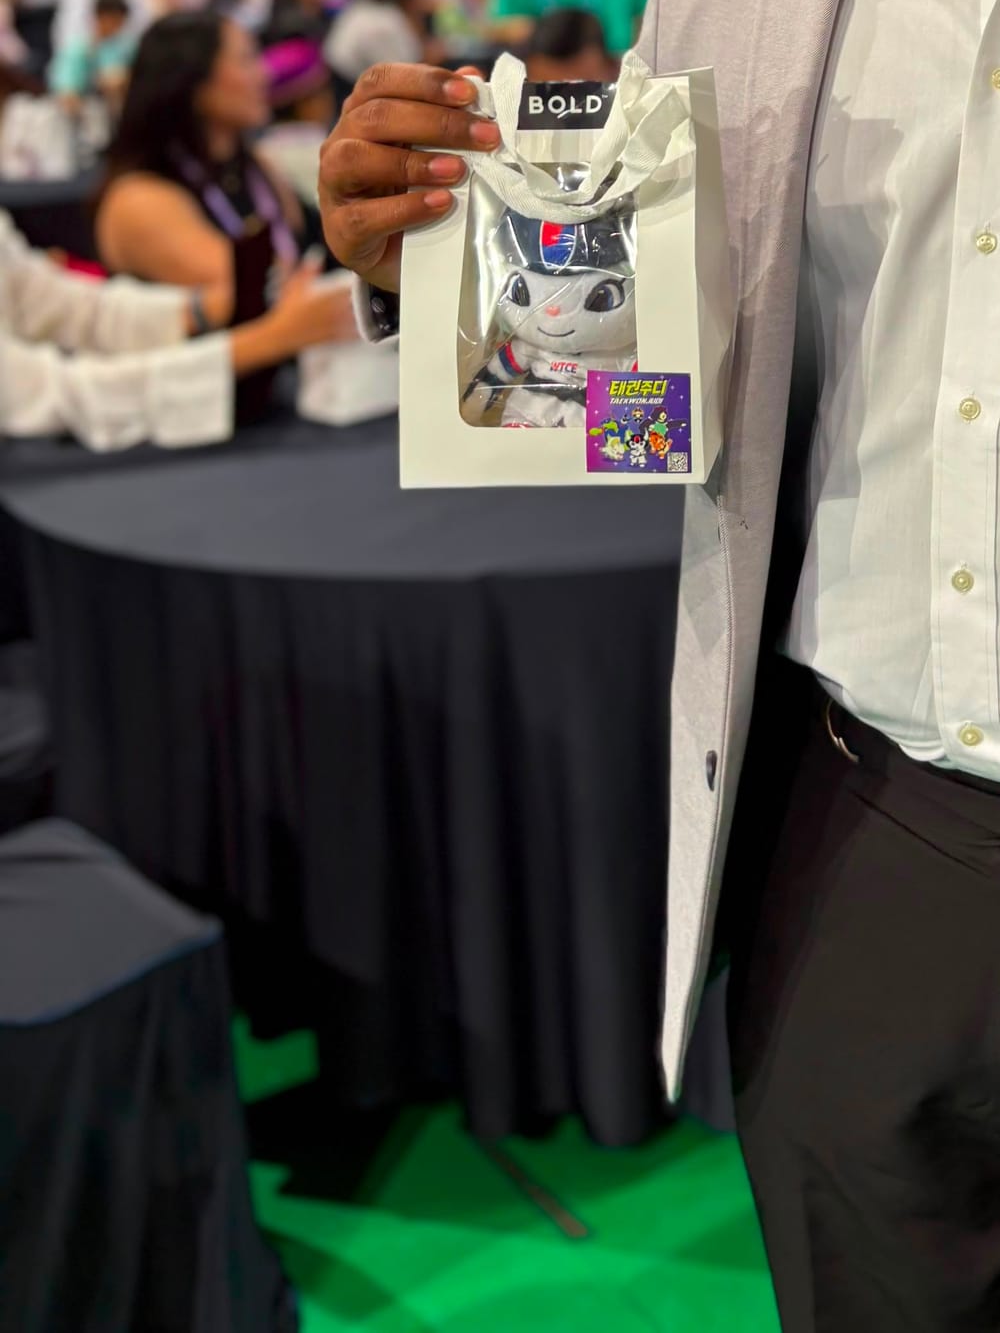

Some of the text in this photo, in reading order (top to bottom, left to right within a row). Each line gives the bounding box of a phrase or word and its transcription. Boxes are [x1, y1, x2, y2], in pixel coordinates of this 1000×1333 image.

[528, 95, 602, 118] BOLD
[550, 361, 578, 373] WTCE
[609, 379, 668, 396] 태권주디
